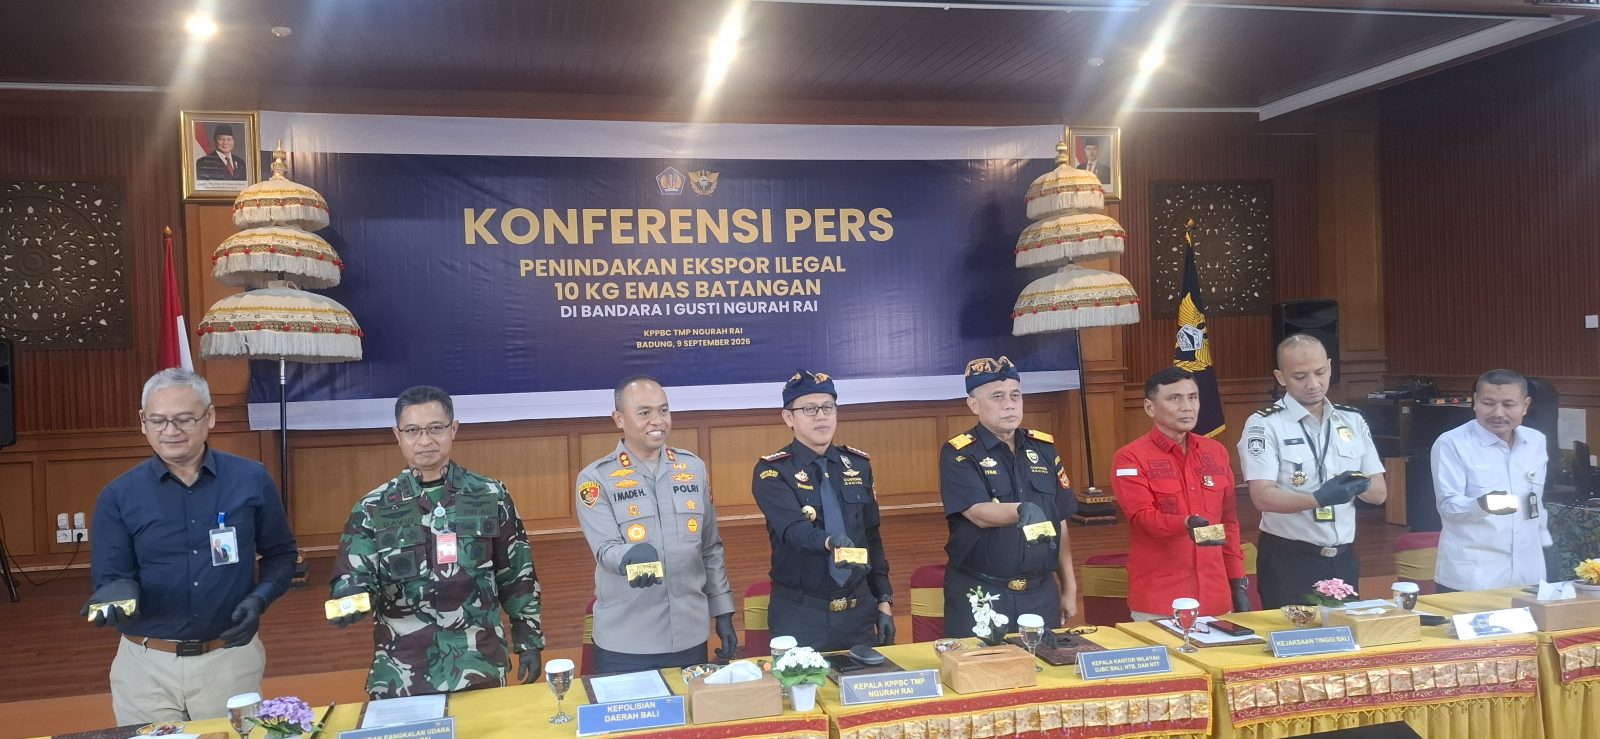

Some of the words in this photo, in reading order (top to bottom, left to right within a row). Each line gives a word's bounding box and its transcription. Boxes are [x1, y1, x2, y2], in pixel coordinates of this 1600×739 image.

[463, 208, 772, 245] KONFERENSI
[785, 207, 894, 243] PERS
[519, 258, 677, 277] PENINDAKAN
[682, 257, 770, 275] EKSPOR
[775, 255, 846, 273] ILEGAL
[554, 282, 579, 300] 10
[585, 282, 620, 300] KG
[625, 280, 690, 299] EMAS
[695, 278, 821, 298] BATANGAN
[560, 305, 577, 318] DI
[581, 303, 662, 318] BANDARA
[666, 303, 670, 316] I
[673, 302, 720, 315] GUSTI
[724, 301, 790, 314] NGURAH
[793, 300, 818, 313] RAI
[643, 329, 672, 337] KPPBC
[692, 328, 728, 336] NGURAH
[729, 327, 743, 335] RAI
[636, 340, 675, 349] BADUNG,
[683, 339, 730, 347] SEPTEMBER
[613, 493, 617, 502] I
[617, 489, 639, 501] MADE
[638, 488, 647, 497] H.
[673, 485, 699, 493] POLRI
[1276, 638, 1315, 647] KEJAKSAAN
[853, 682, 883, 690] KEPALA
[868, 689, 900, 698] NGURAH
[607, 701, 656, 713] KEPOLISIAN
[604, 713, 639, 722] DAERAH
[640, 710, 660, 719] BALI
[383, 729, 427, 739] PANGKALAN
[426, 727, 451, 735] UDARA
